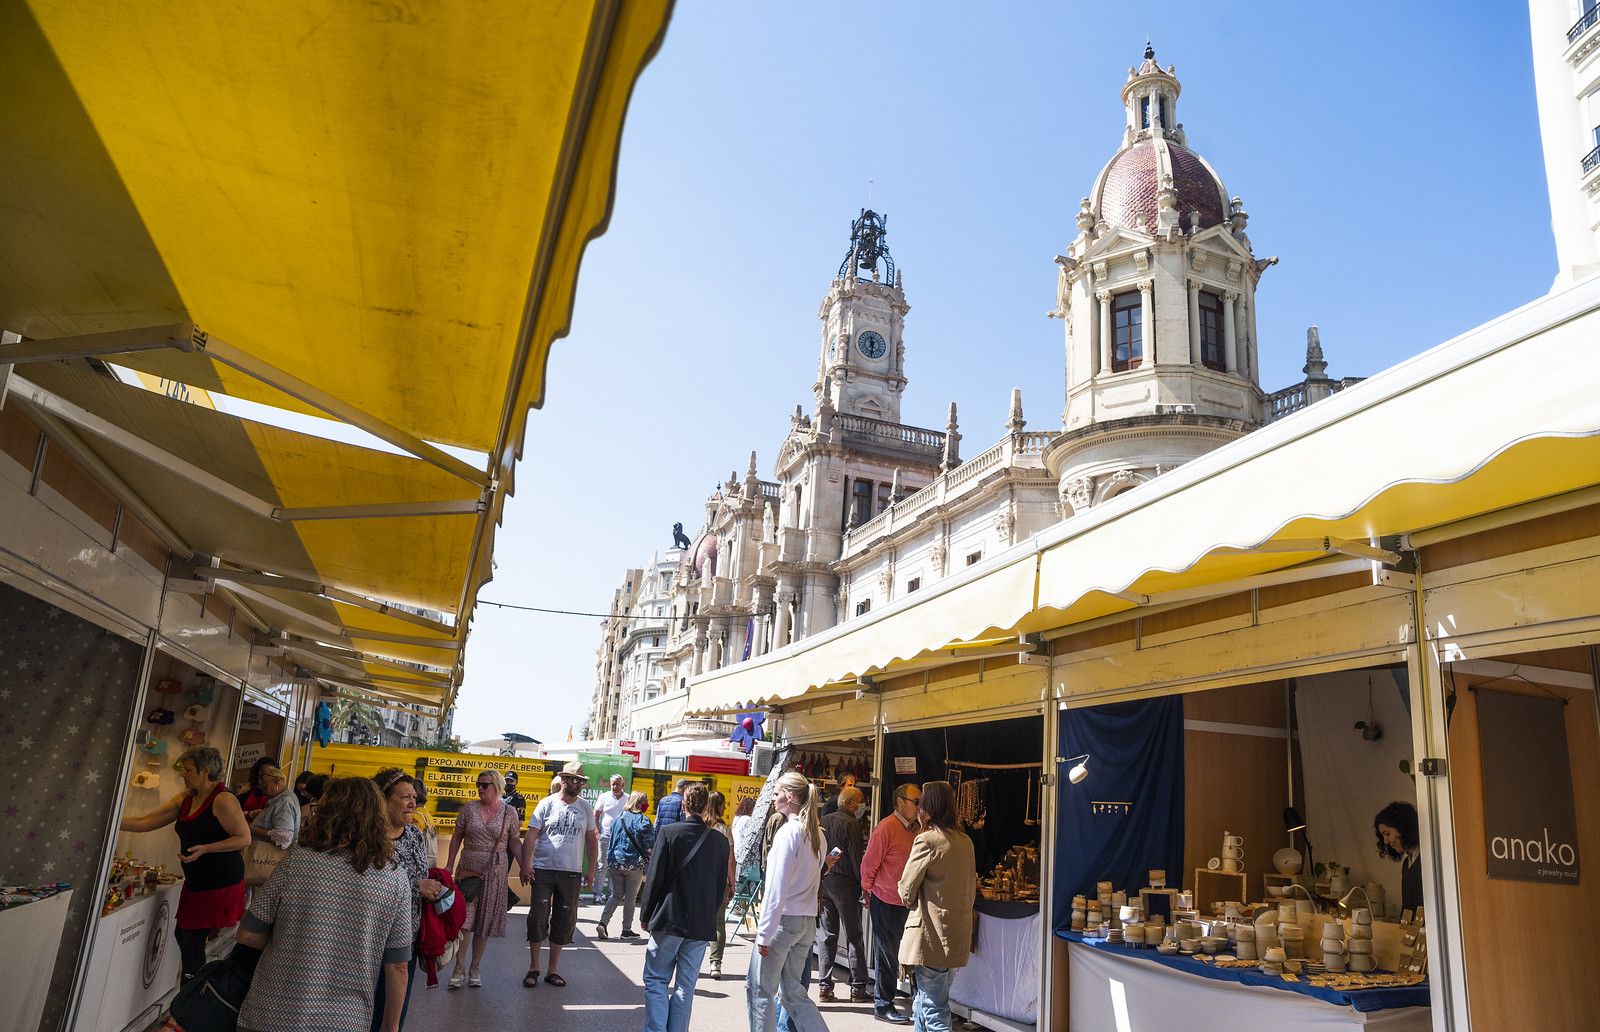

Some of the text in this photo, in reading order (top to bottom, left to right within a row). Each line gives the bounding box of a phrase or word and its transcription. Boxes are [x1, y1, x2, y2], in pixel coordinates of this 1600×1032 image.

[429, 758, 453, 767] EXPO.
[455, 760, 476, 768] ANNI
[484, 762, 509, 770] JOSEF
[510, 764, 544, 773] ALBERS:
[428, 773, 438, 781] EL
[440, 774, 462, 782] ARTE
[463, 775, 470, 783] Y
[426, 787, 454, 796] HASTA
[456, 789, 466, 797] EL
[1491, 827, 1575, 866] anako
